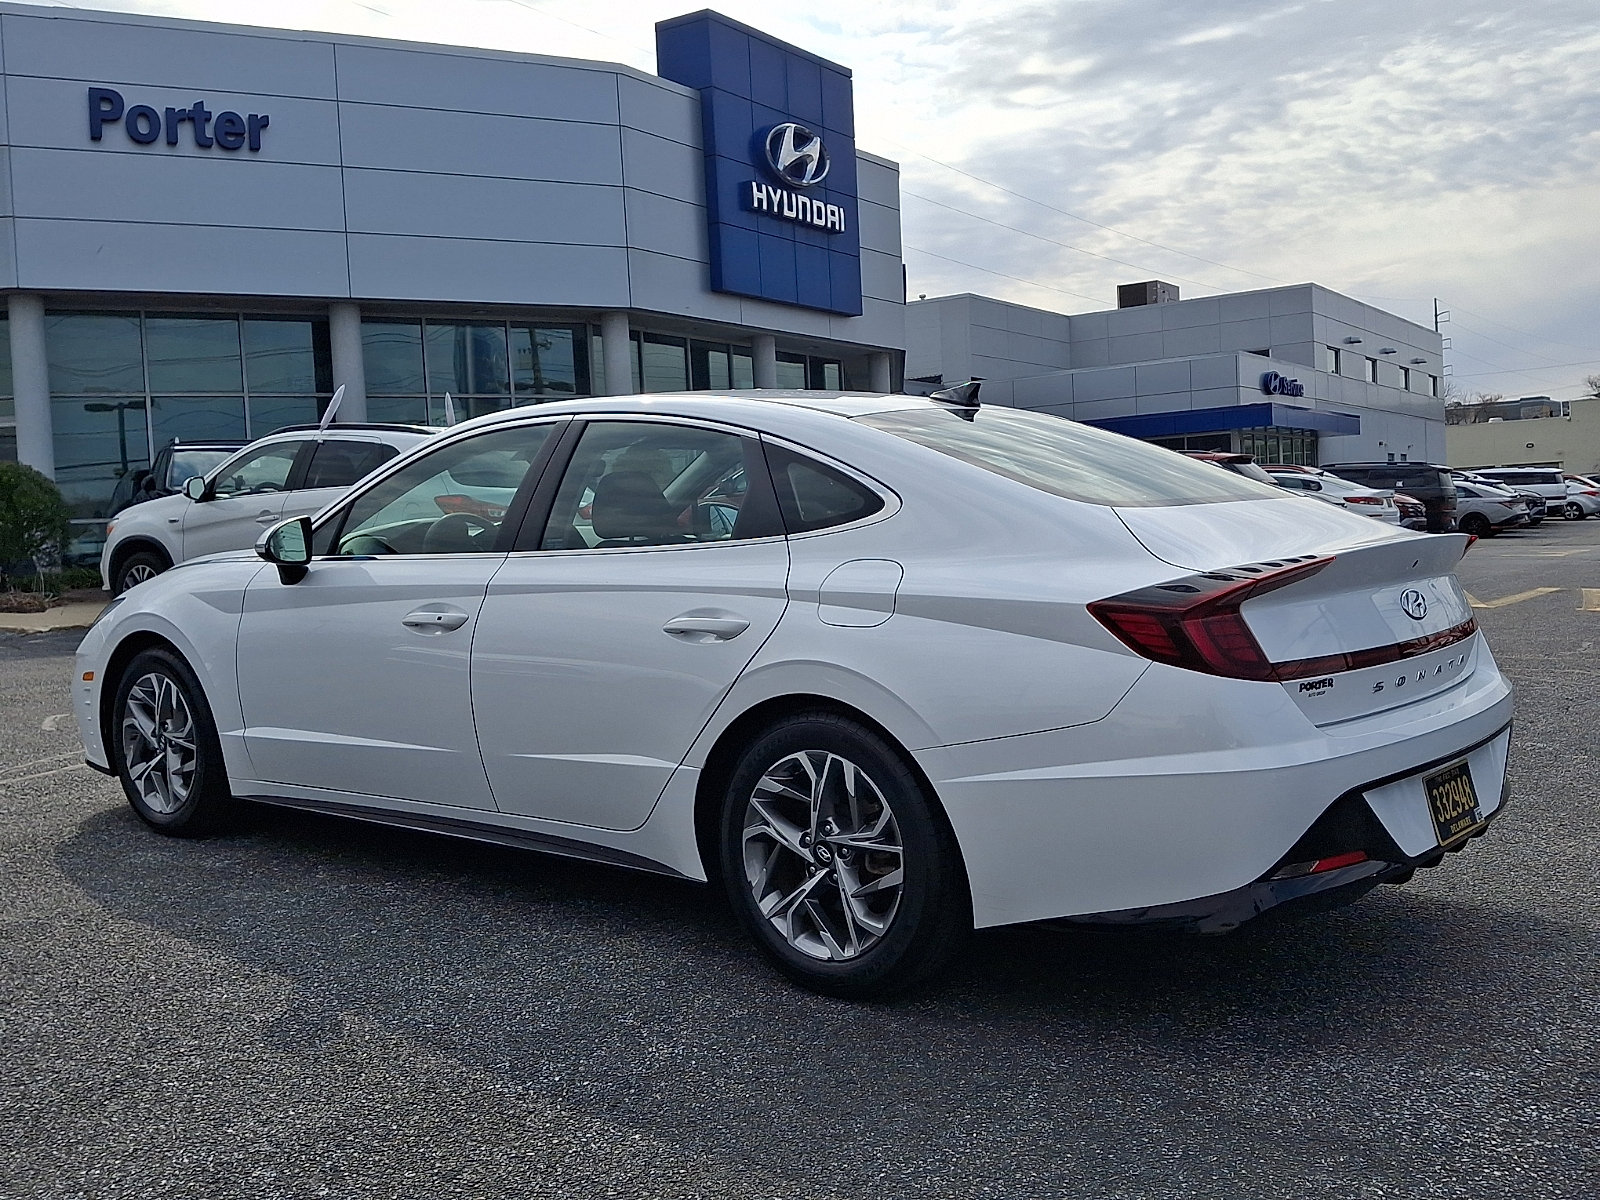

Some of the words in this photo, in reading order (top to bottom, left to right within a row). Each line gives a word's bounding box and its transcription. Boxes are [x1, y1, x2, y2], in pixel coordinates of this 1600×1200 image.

[88, 86, 270, 152] Porter
[751, 181, 846, 232] HYUNDAI
[1299, 677, 1334, 692] PORTER
[1433, 775, 1475, 822] 332948
